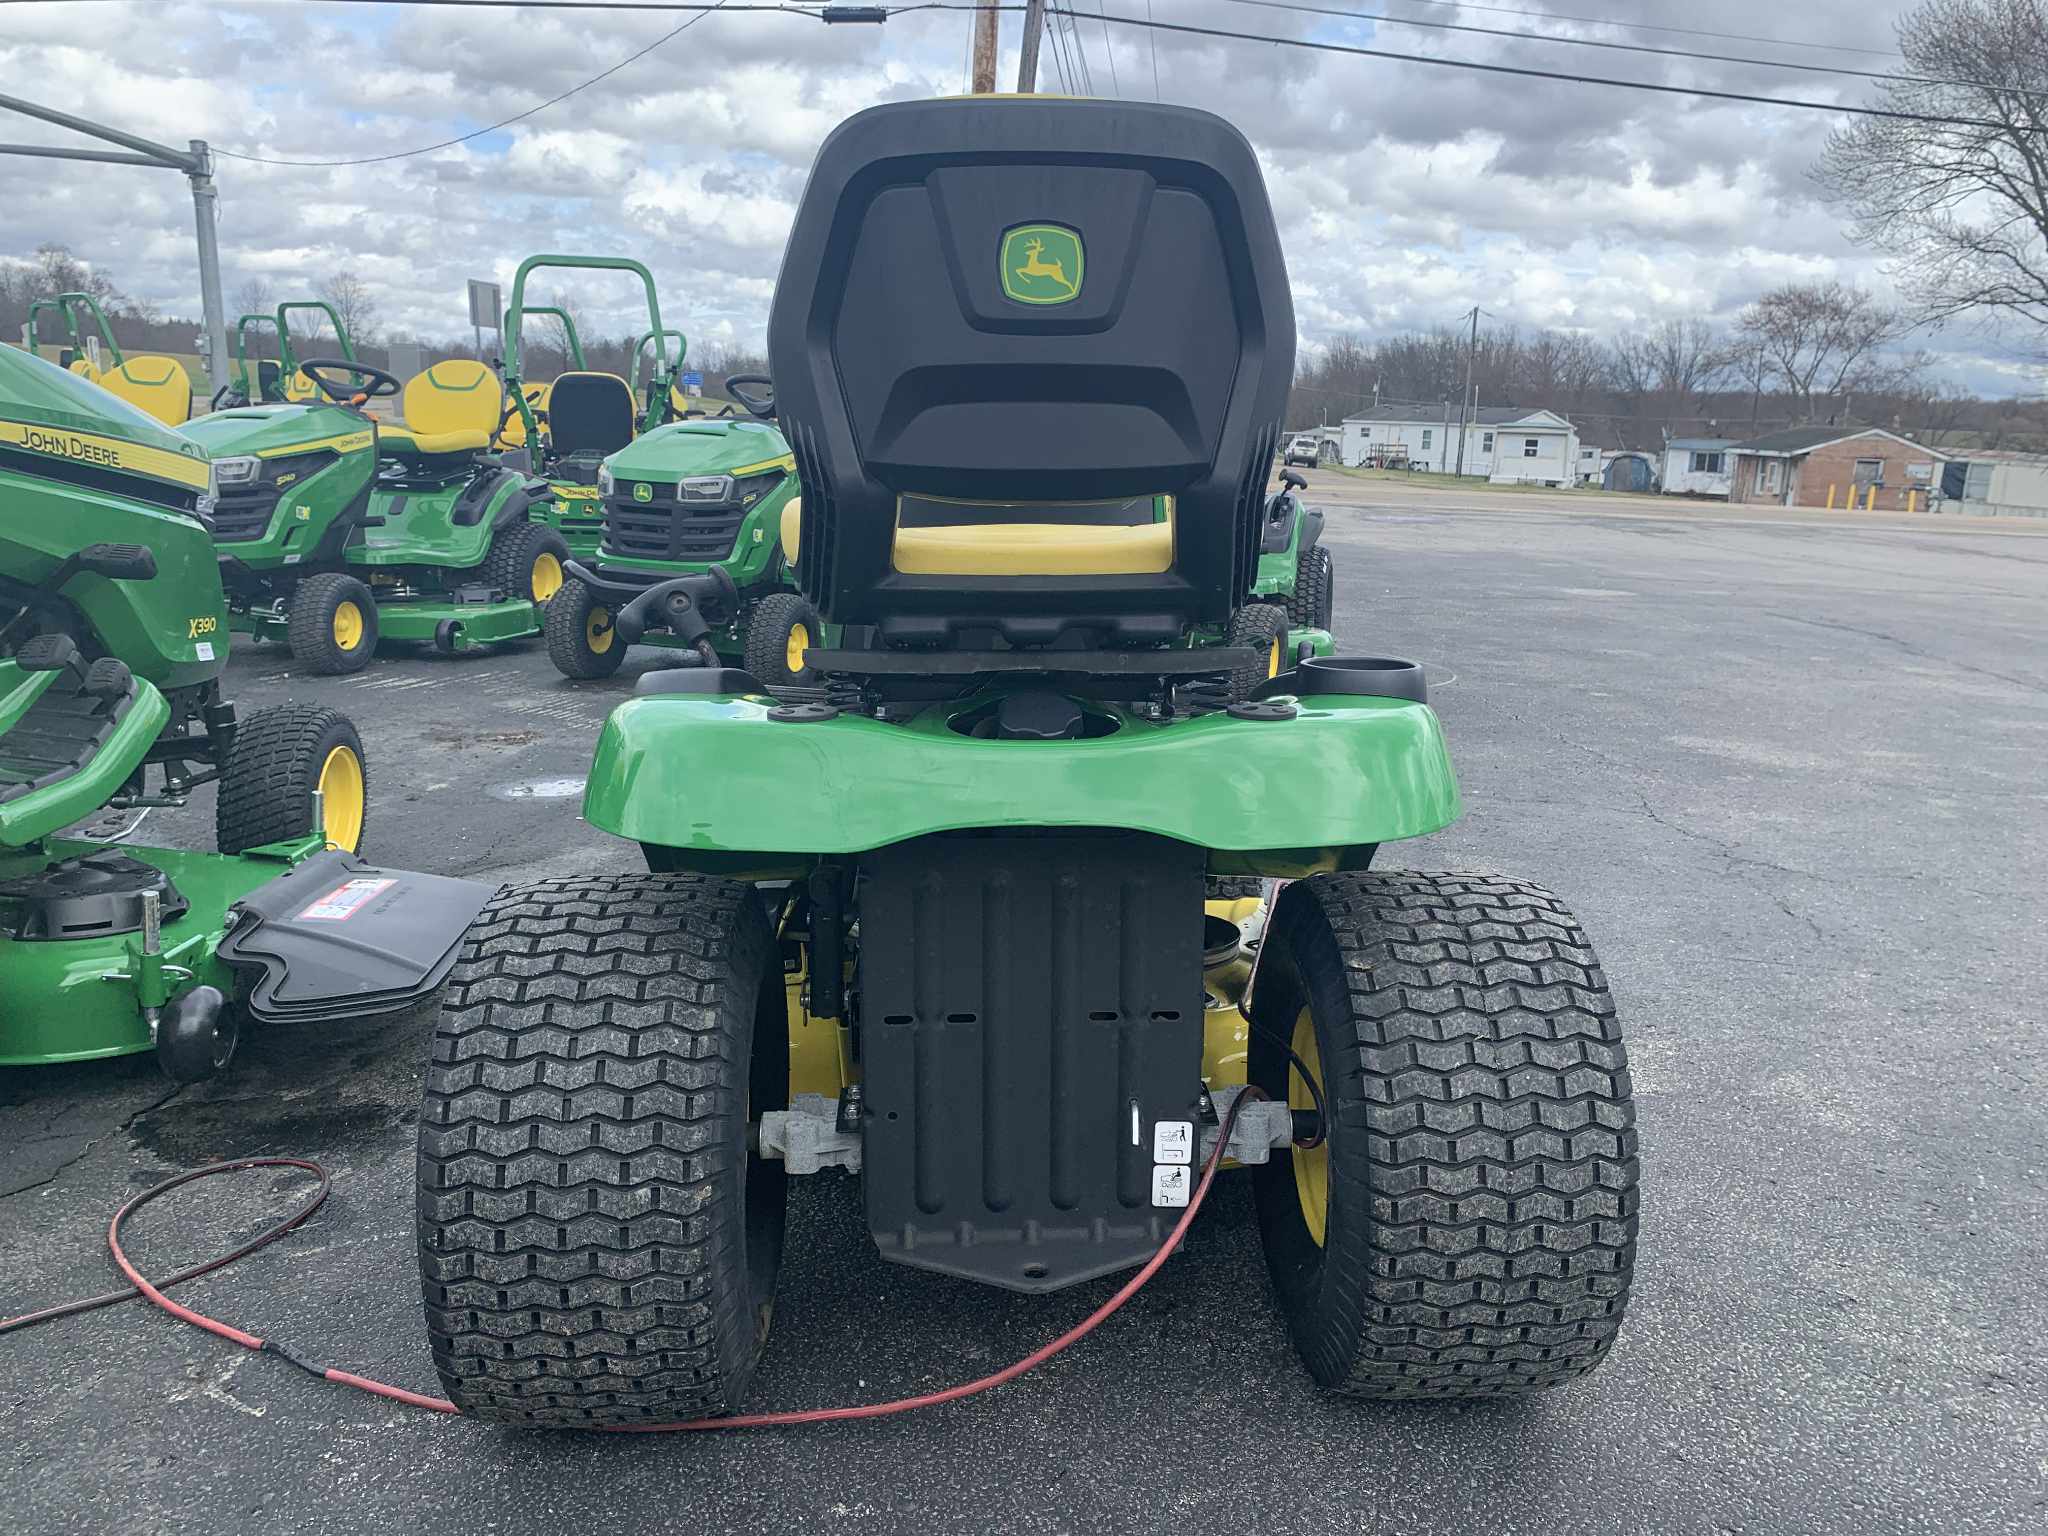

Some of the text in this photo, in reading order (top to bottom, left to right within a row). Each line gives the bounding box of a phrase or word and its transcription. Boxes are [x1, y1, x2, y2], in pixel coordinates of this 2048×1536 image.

[20, 426, 121, 466] JOHN DEERE
[188, 616, 217, 639] X390
